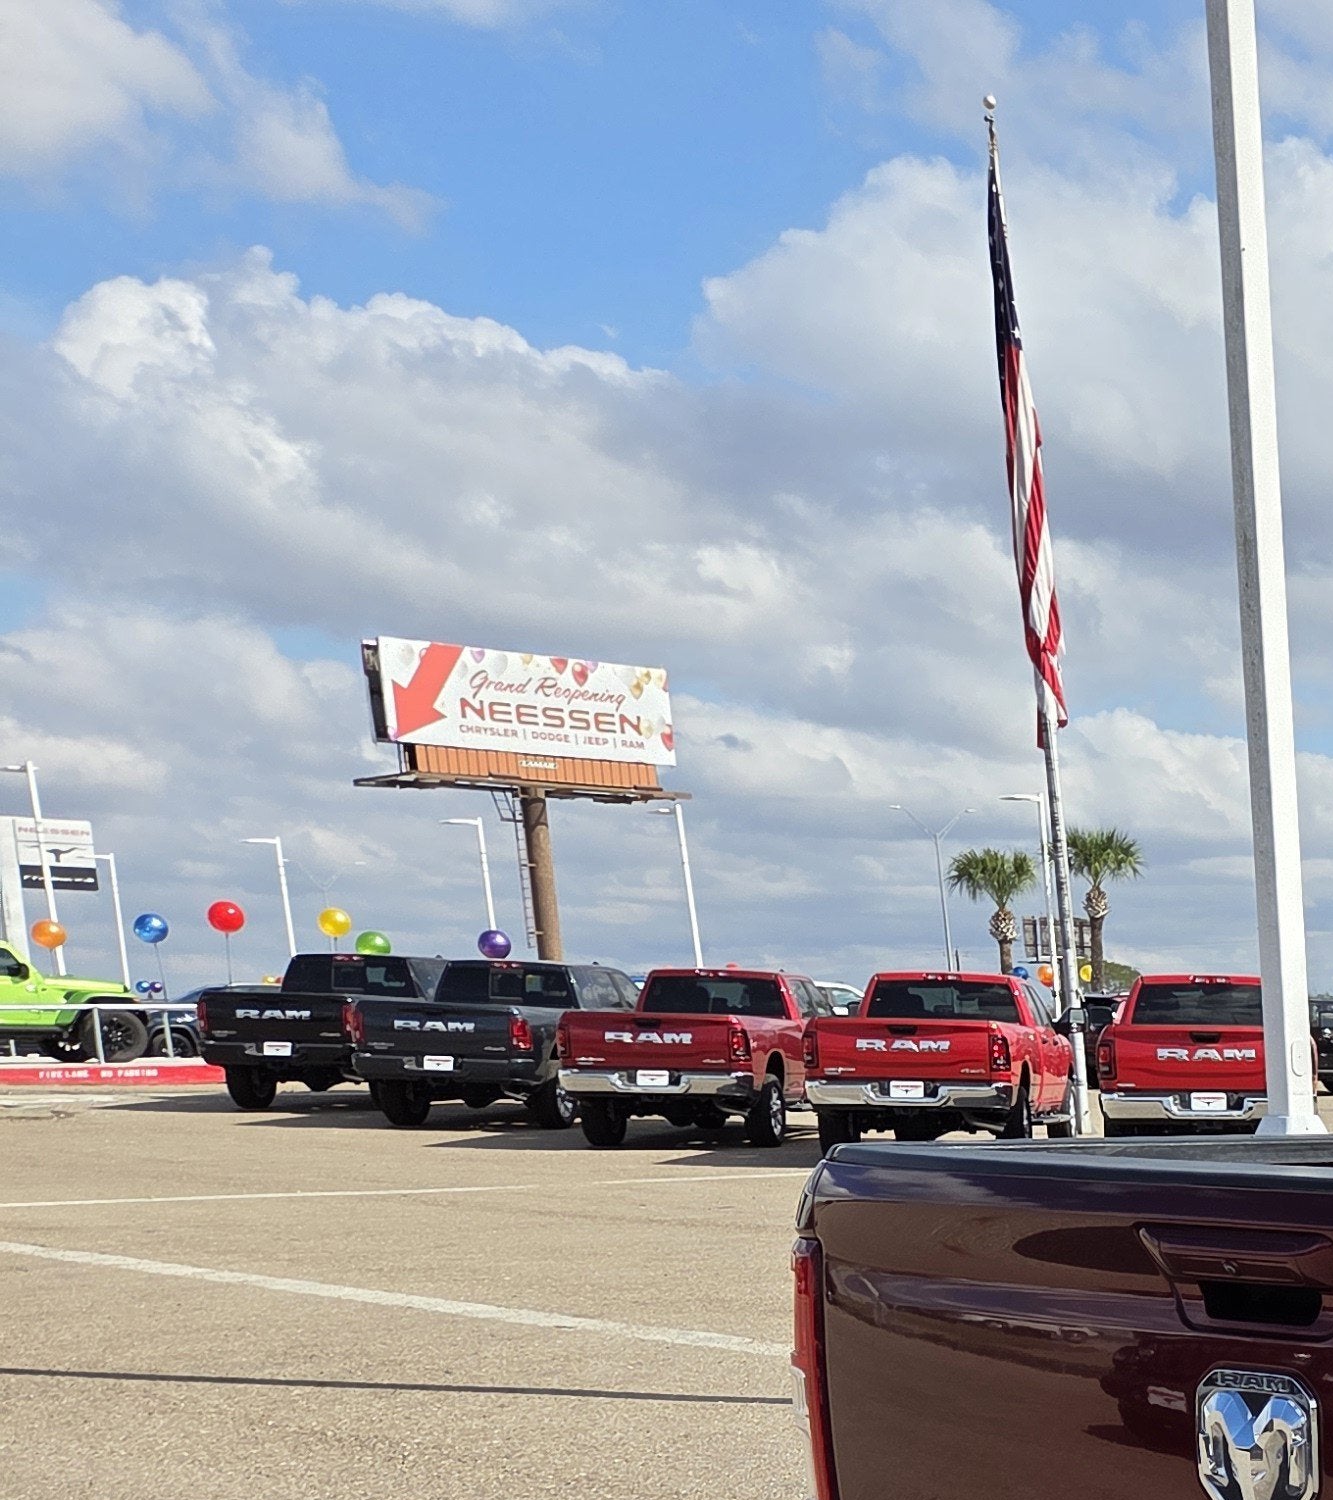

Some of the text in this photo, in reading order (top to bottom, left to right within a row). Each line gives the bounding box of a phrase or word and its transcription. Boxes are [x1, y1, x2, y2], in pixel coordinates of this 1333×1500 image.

[469, 669, 627, 712] Grand Reopening
[459, 697, 643, 736] NEESSEN
[459, 724, 645, 750] CHRYSLER DODGE JEEP RAM
[235, 1009, 311, 1020] RAM
[393, 1019, 475, 1033] RAM
[604, 1031, 693, 1044] RAM
[856, 1038, 950, 1053] RAM
[1156, 1048, 1257, 1062] RAM
[1216, 1371, 1290, 1393] RAM
